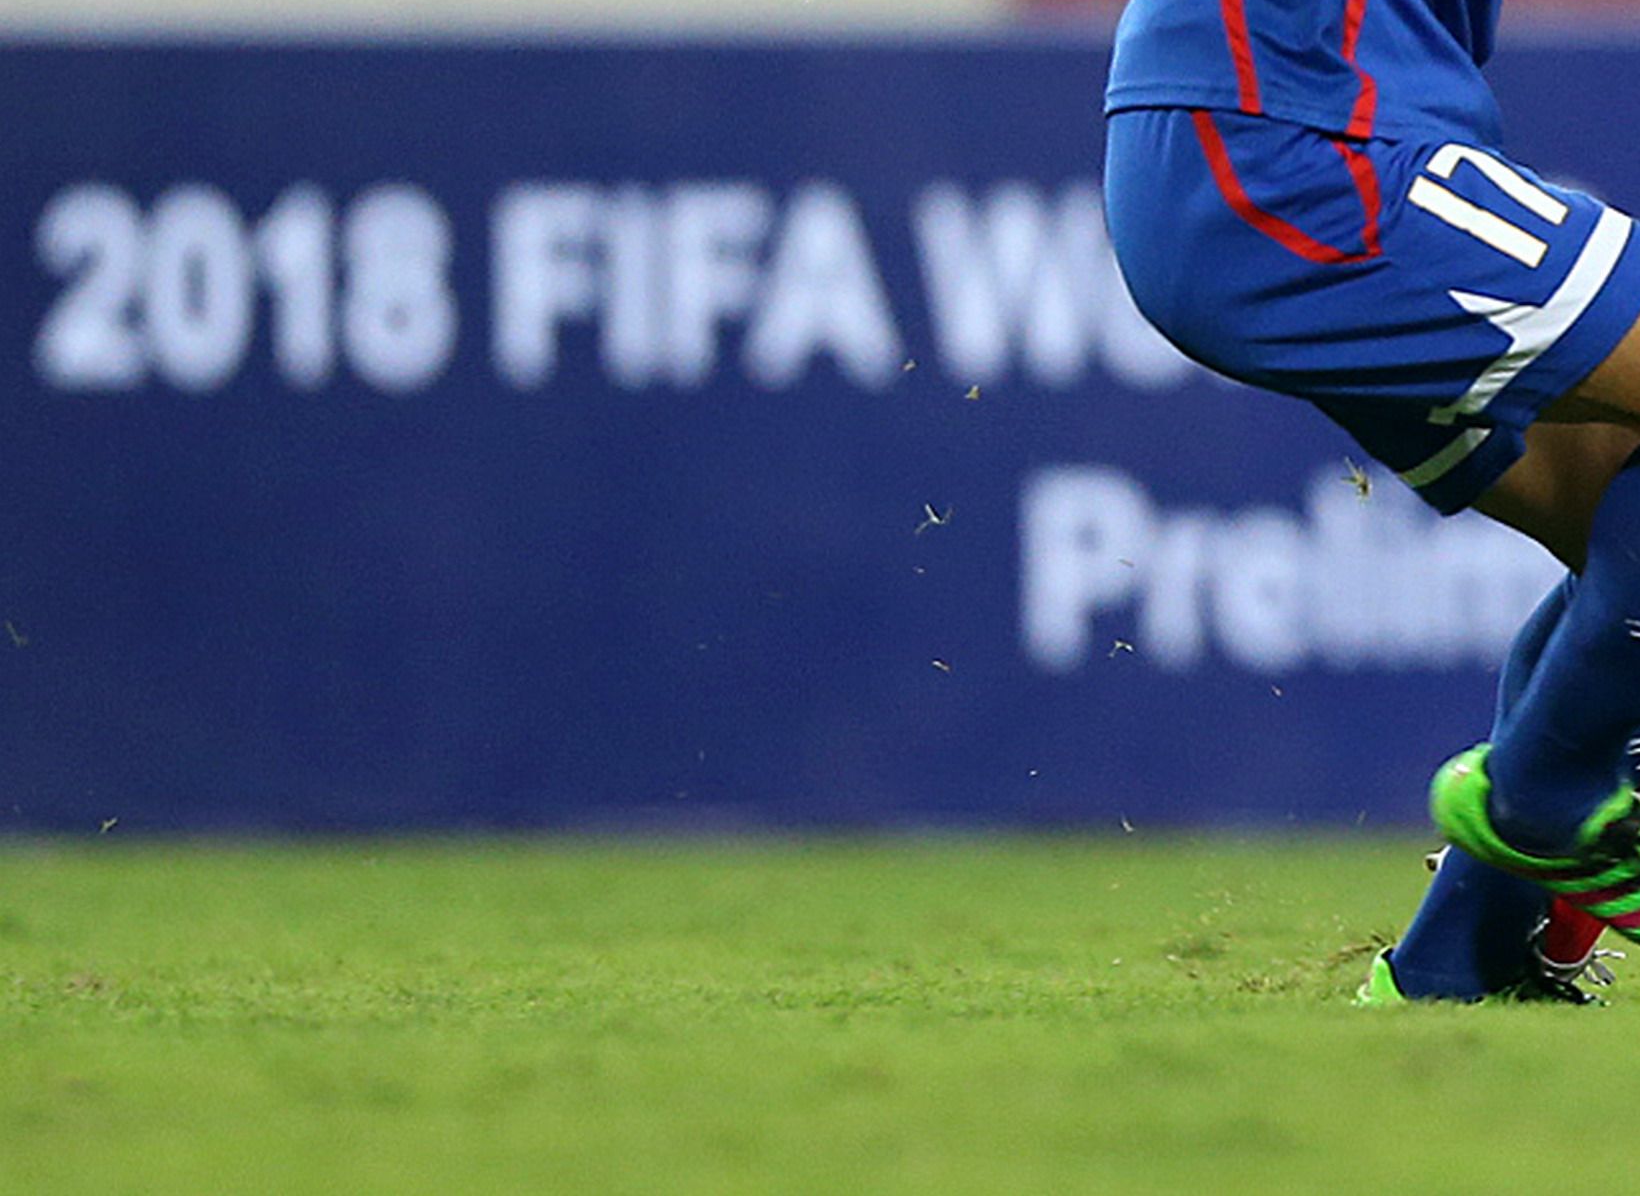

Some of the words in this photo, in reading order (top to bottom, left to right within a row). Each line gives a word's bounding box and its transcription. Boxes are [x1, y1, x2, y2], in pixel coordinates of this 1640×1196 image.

[35, 182, 457, 391] 2018
[490, 182, 903, 391] FIFA
[1407, 142, 1571, 269] 17
